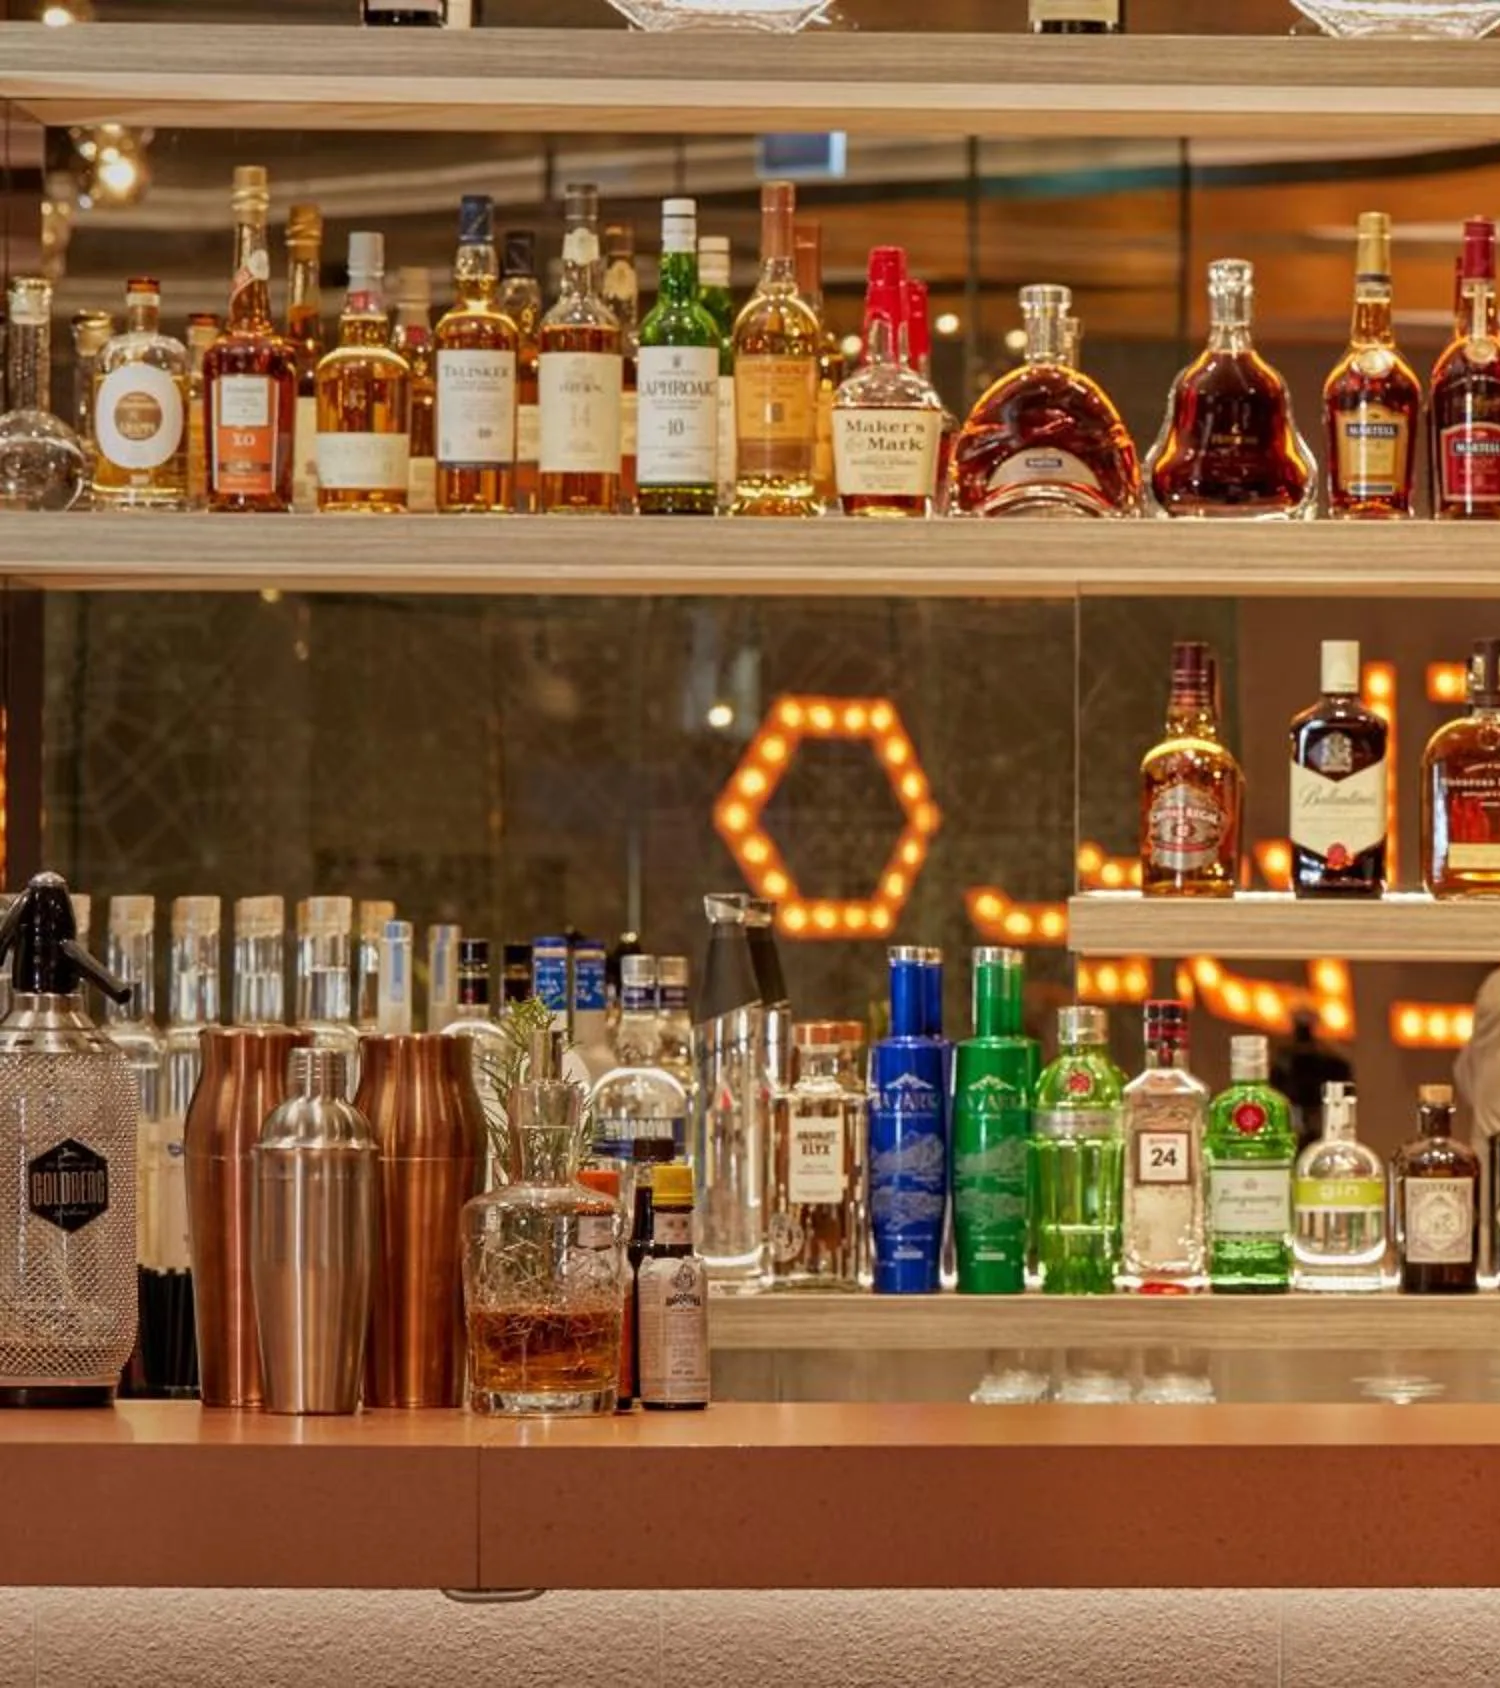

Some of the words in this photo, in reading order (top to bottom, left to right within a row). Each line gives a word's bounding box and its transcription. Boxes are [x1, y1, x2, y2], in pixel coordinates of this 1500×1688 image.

[845, 419, 926, 433] Maker's
[867, 437, 925, 451] Mark
[1151, 1148, 1178, 1167] 24
[33, 1170, 106, 1206] GOLDBERG
[1319, 1182, 1360, 1201] gin
